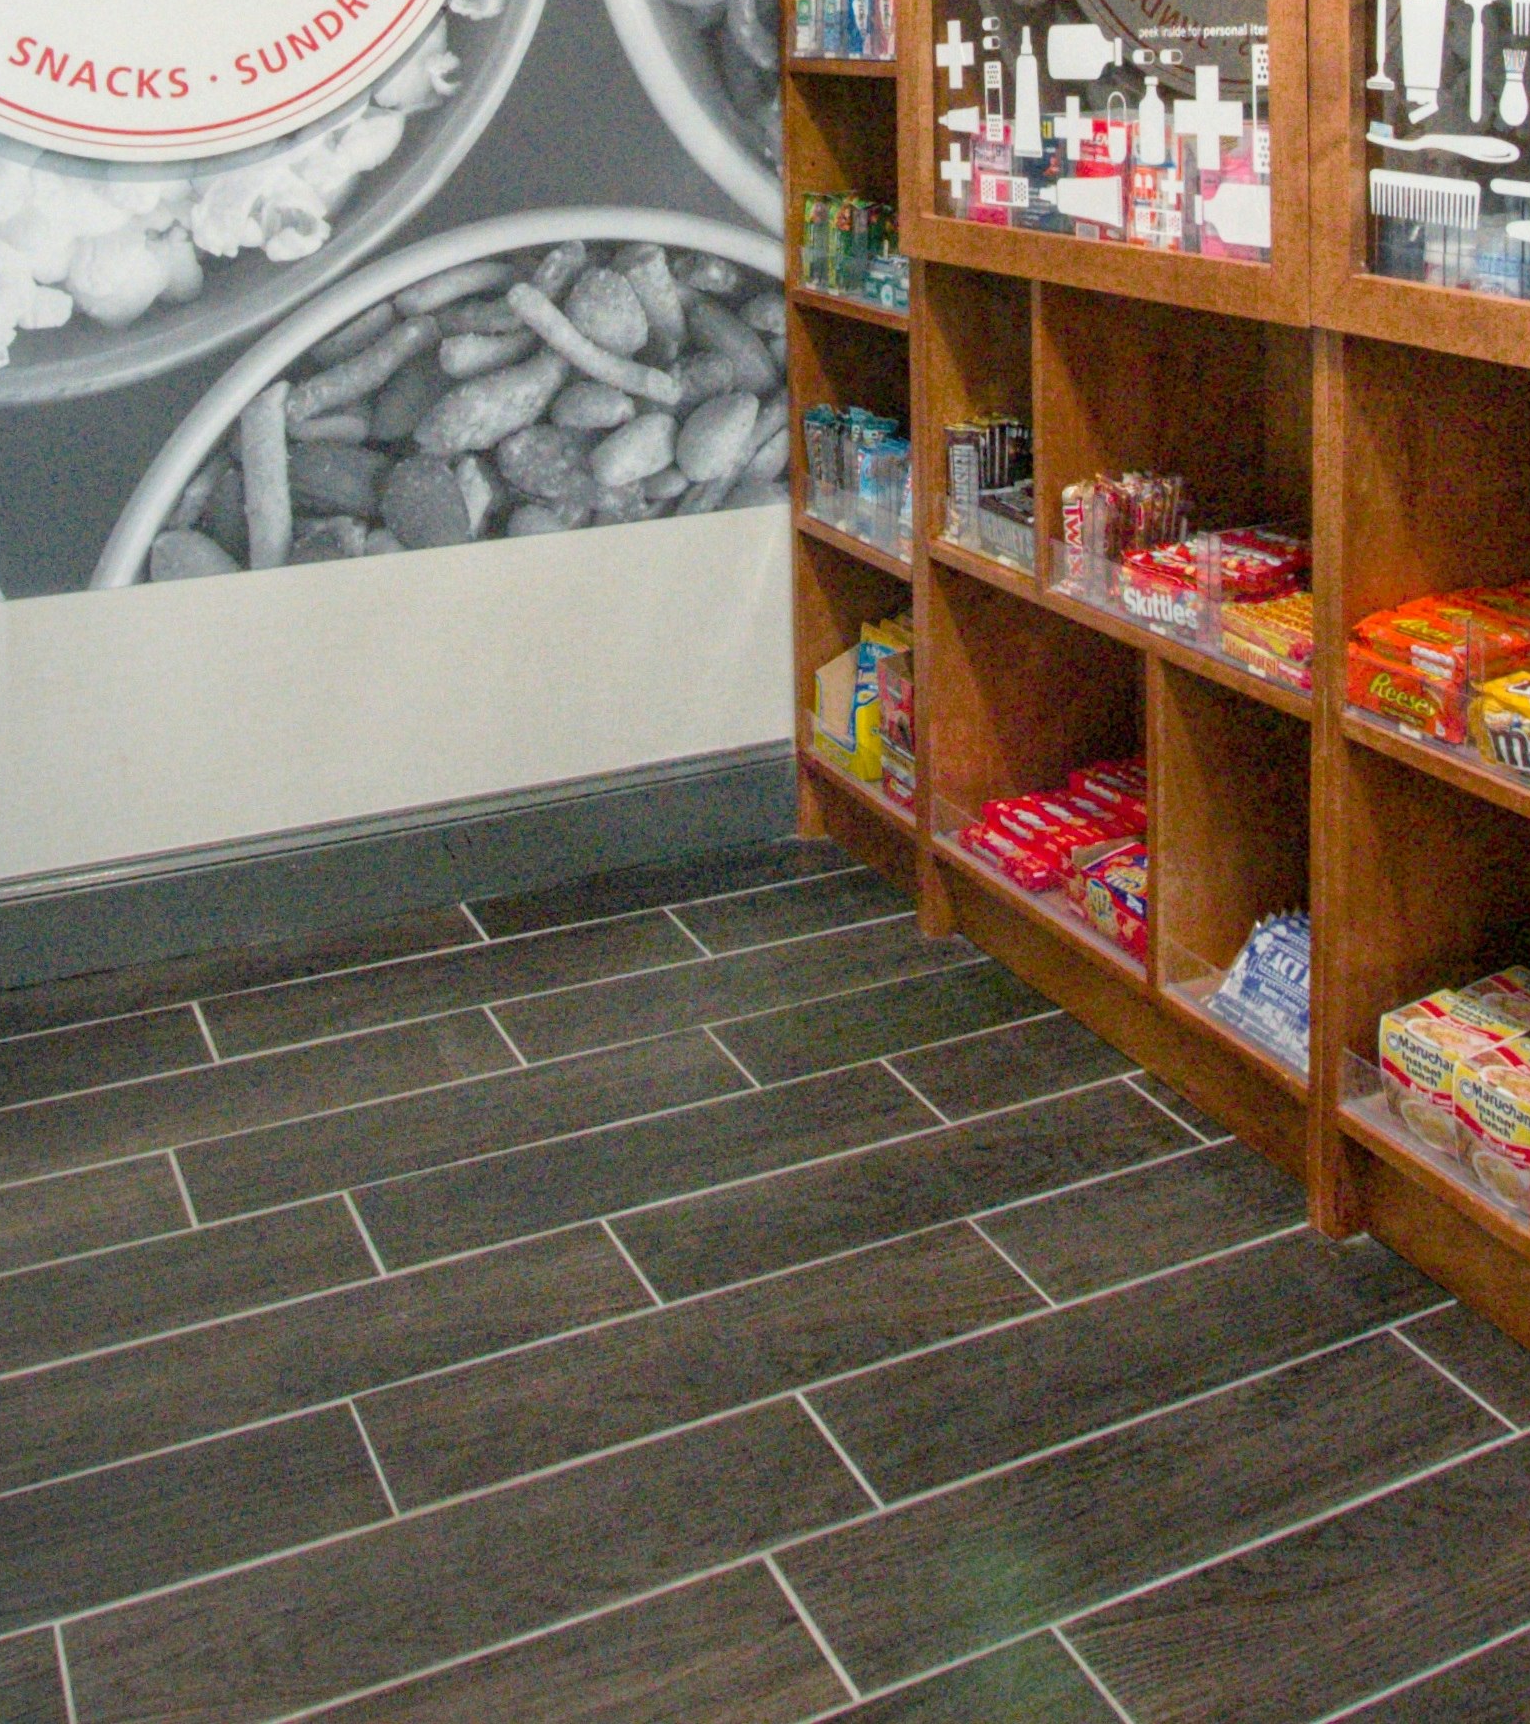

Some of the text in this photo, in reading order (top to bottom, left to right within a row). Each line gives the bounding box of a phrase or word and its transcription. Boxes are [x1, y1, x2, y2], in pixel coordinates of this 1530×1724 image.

[1203, 22, 1248, 39] personal
[7, 34, 189, 99] SNACKS
[1123, 587, 1199, 629] Skittles
